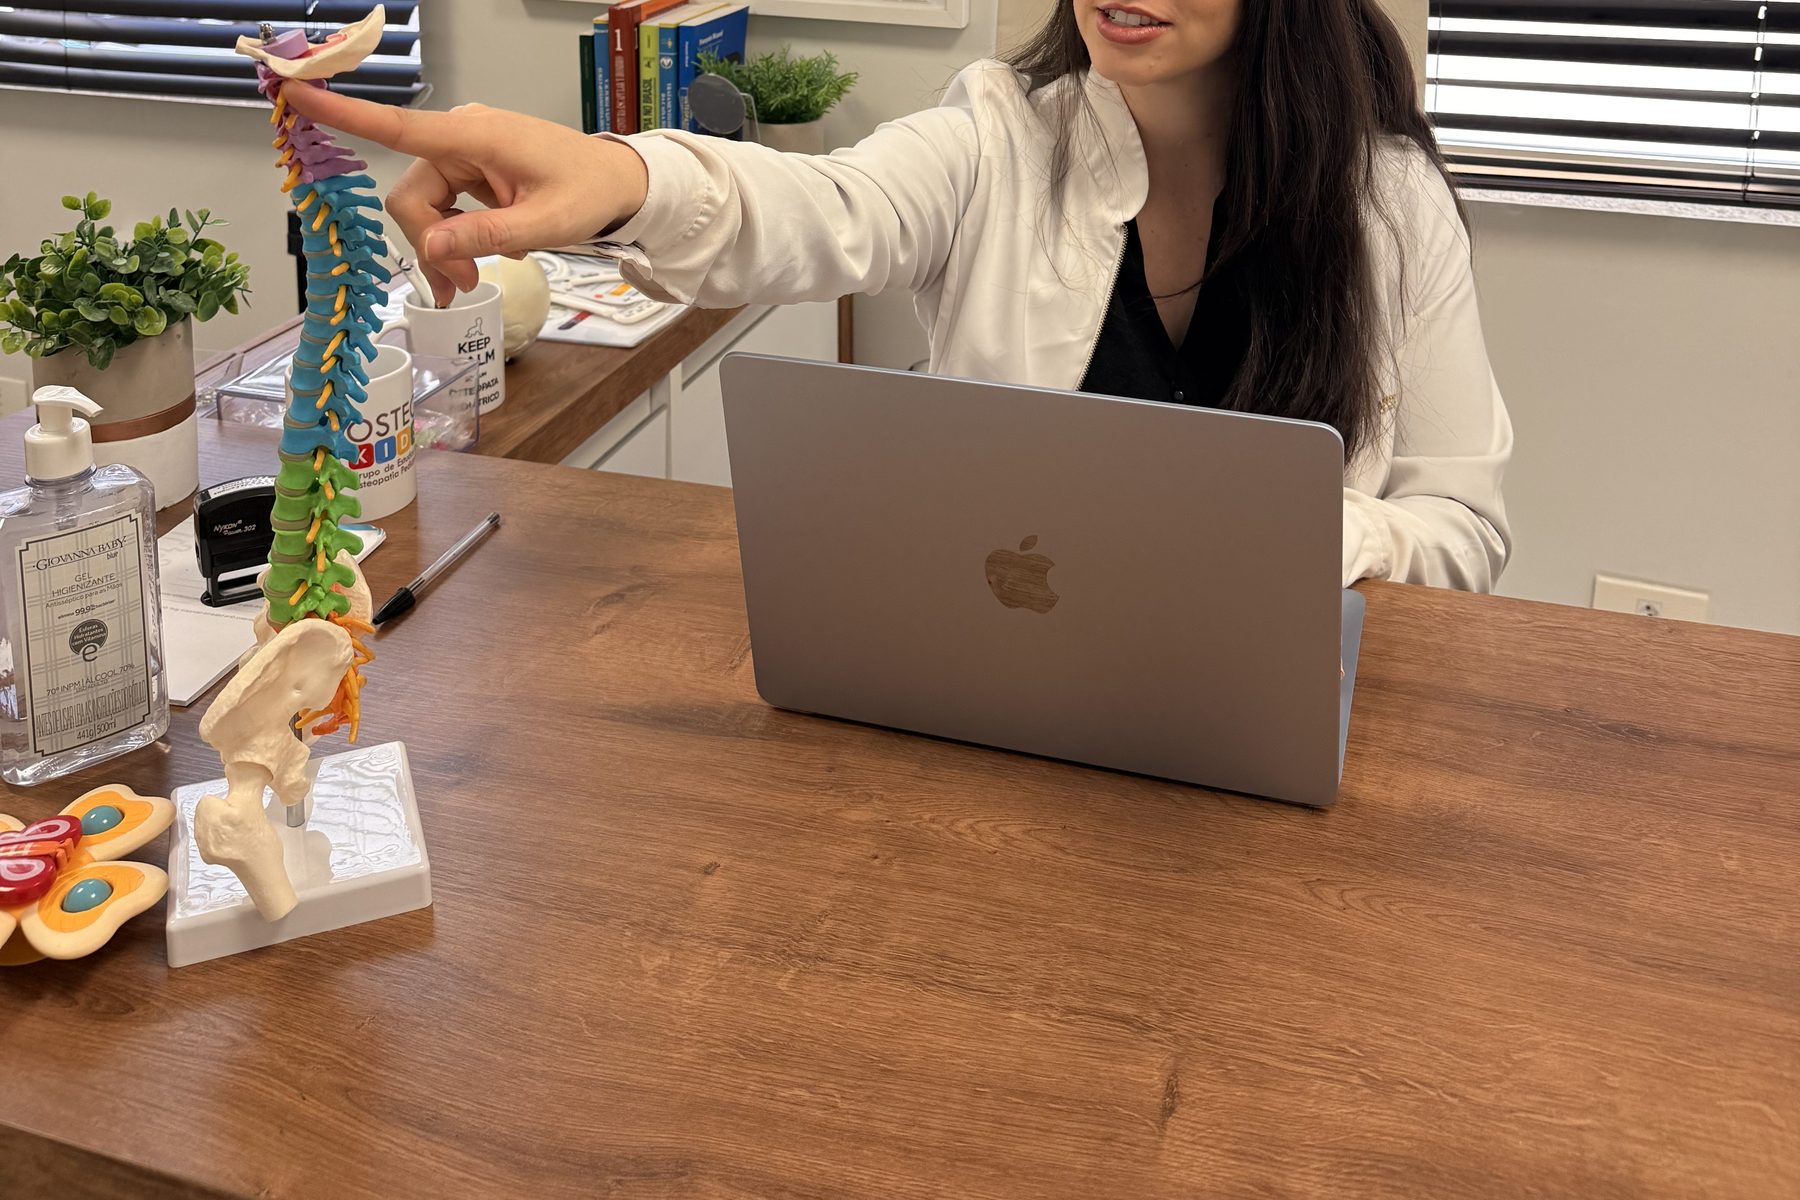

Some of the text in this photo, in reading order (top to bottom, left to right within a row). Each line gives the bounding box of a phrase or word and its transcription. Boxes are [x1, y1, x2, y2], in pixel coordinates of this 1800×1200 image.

[458, 336, 491, 354] KEEP
[358, 469, 380, 479] rupo
[384, 464, 395, 473] de
[359, 471, 399, 488] steopatia
[243, 524, 257, 533] 302
[36, 536, 126, 571] GIOVANNA BABY
[106, 551, 119, 560] blue
[52, 573, 117, 597] HIGIENIZANTE
[74, 572, 93, 583] GEL
[85, 590, 98, 599] para
